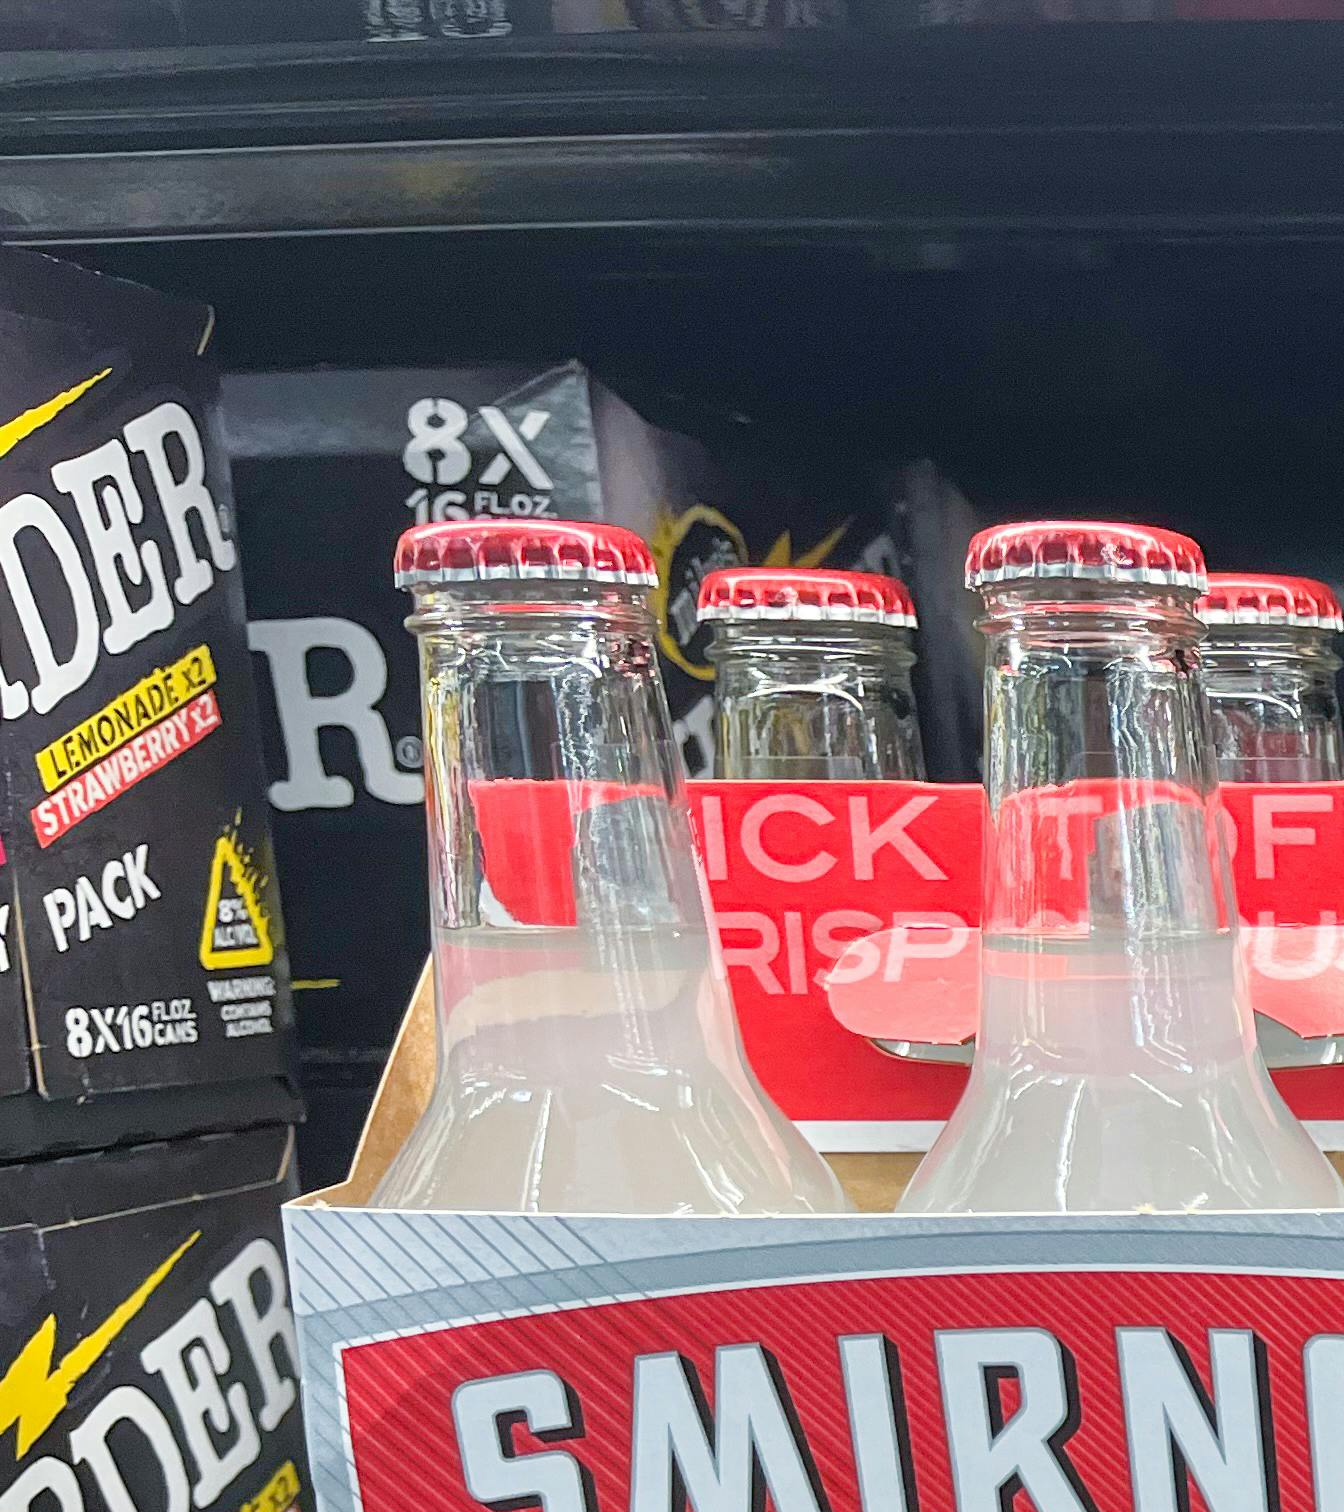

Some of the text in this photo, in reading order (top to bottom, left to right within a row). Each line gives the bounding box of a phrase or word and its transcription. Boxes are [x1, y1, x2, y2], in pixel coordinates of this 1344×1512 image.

[37, 712, 190, 837] STRAWBERRY
[49, 671, 180, 780] LEMONADE
[43, 843, 161, 953] PACK
